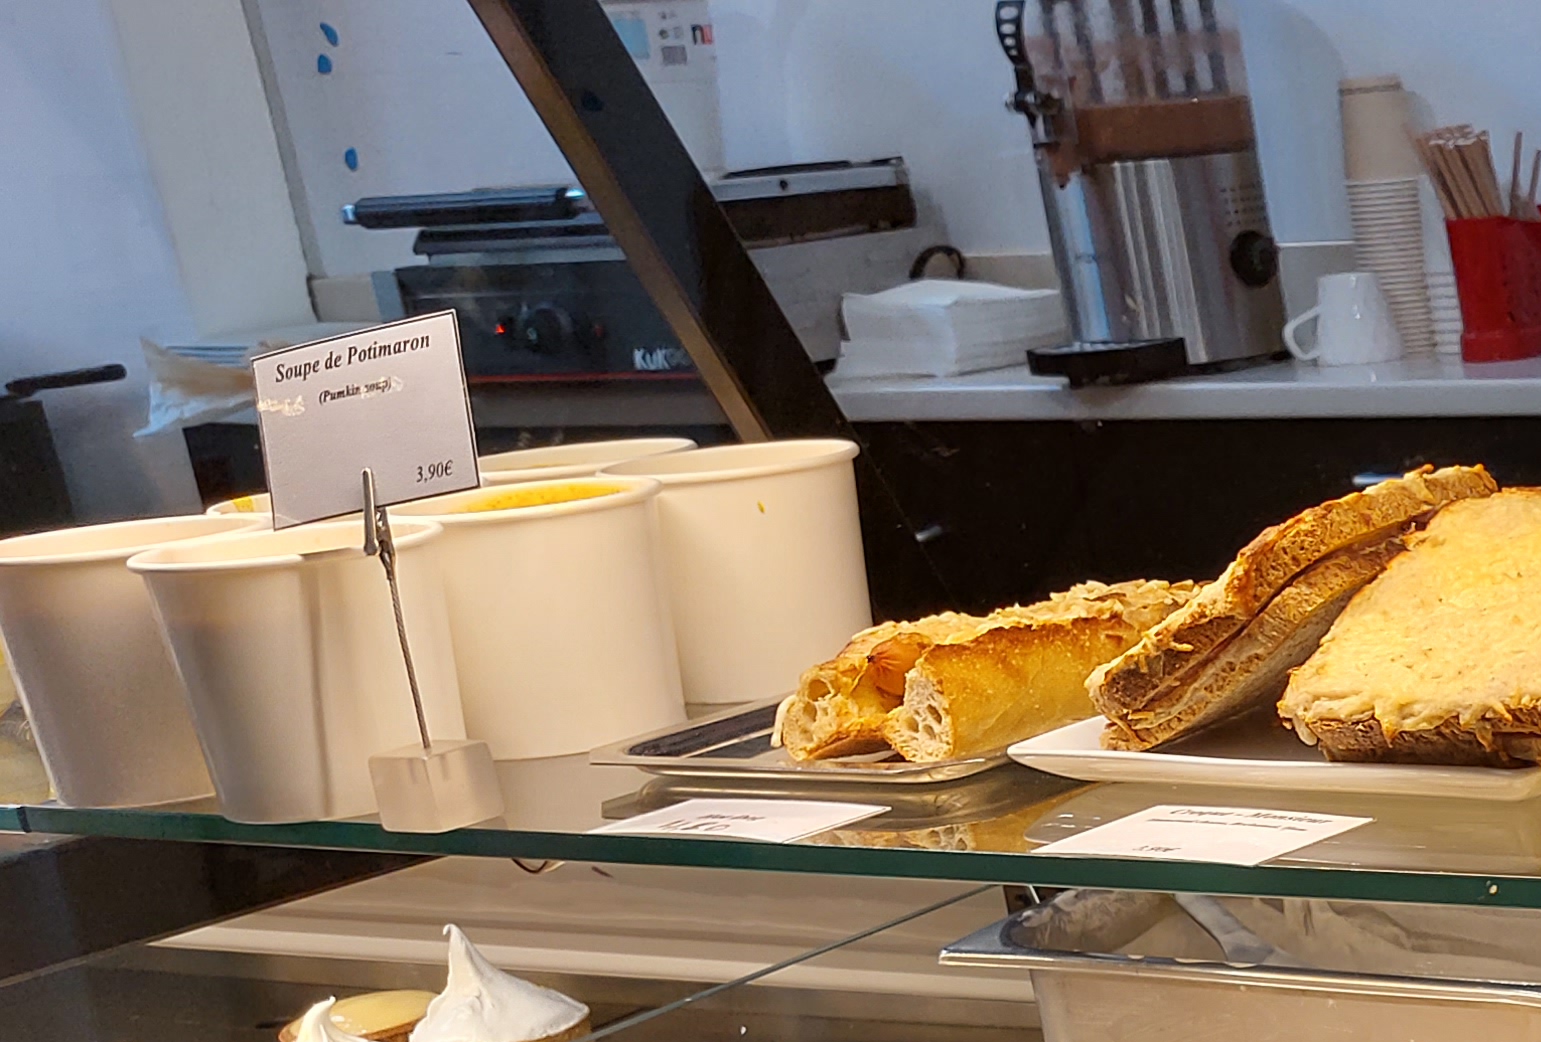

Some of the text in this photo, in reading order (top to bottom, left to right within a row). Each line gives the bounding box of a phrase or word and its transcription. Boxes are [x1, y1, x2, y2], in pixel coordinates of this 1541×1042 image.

[275, 334, 431, 383] Soupe de Potimaron
[318, 386, 360, 405] (Pumkin
[416, 459, 453, 485] 3,90€
